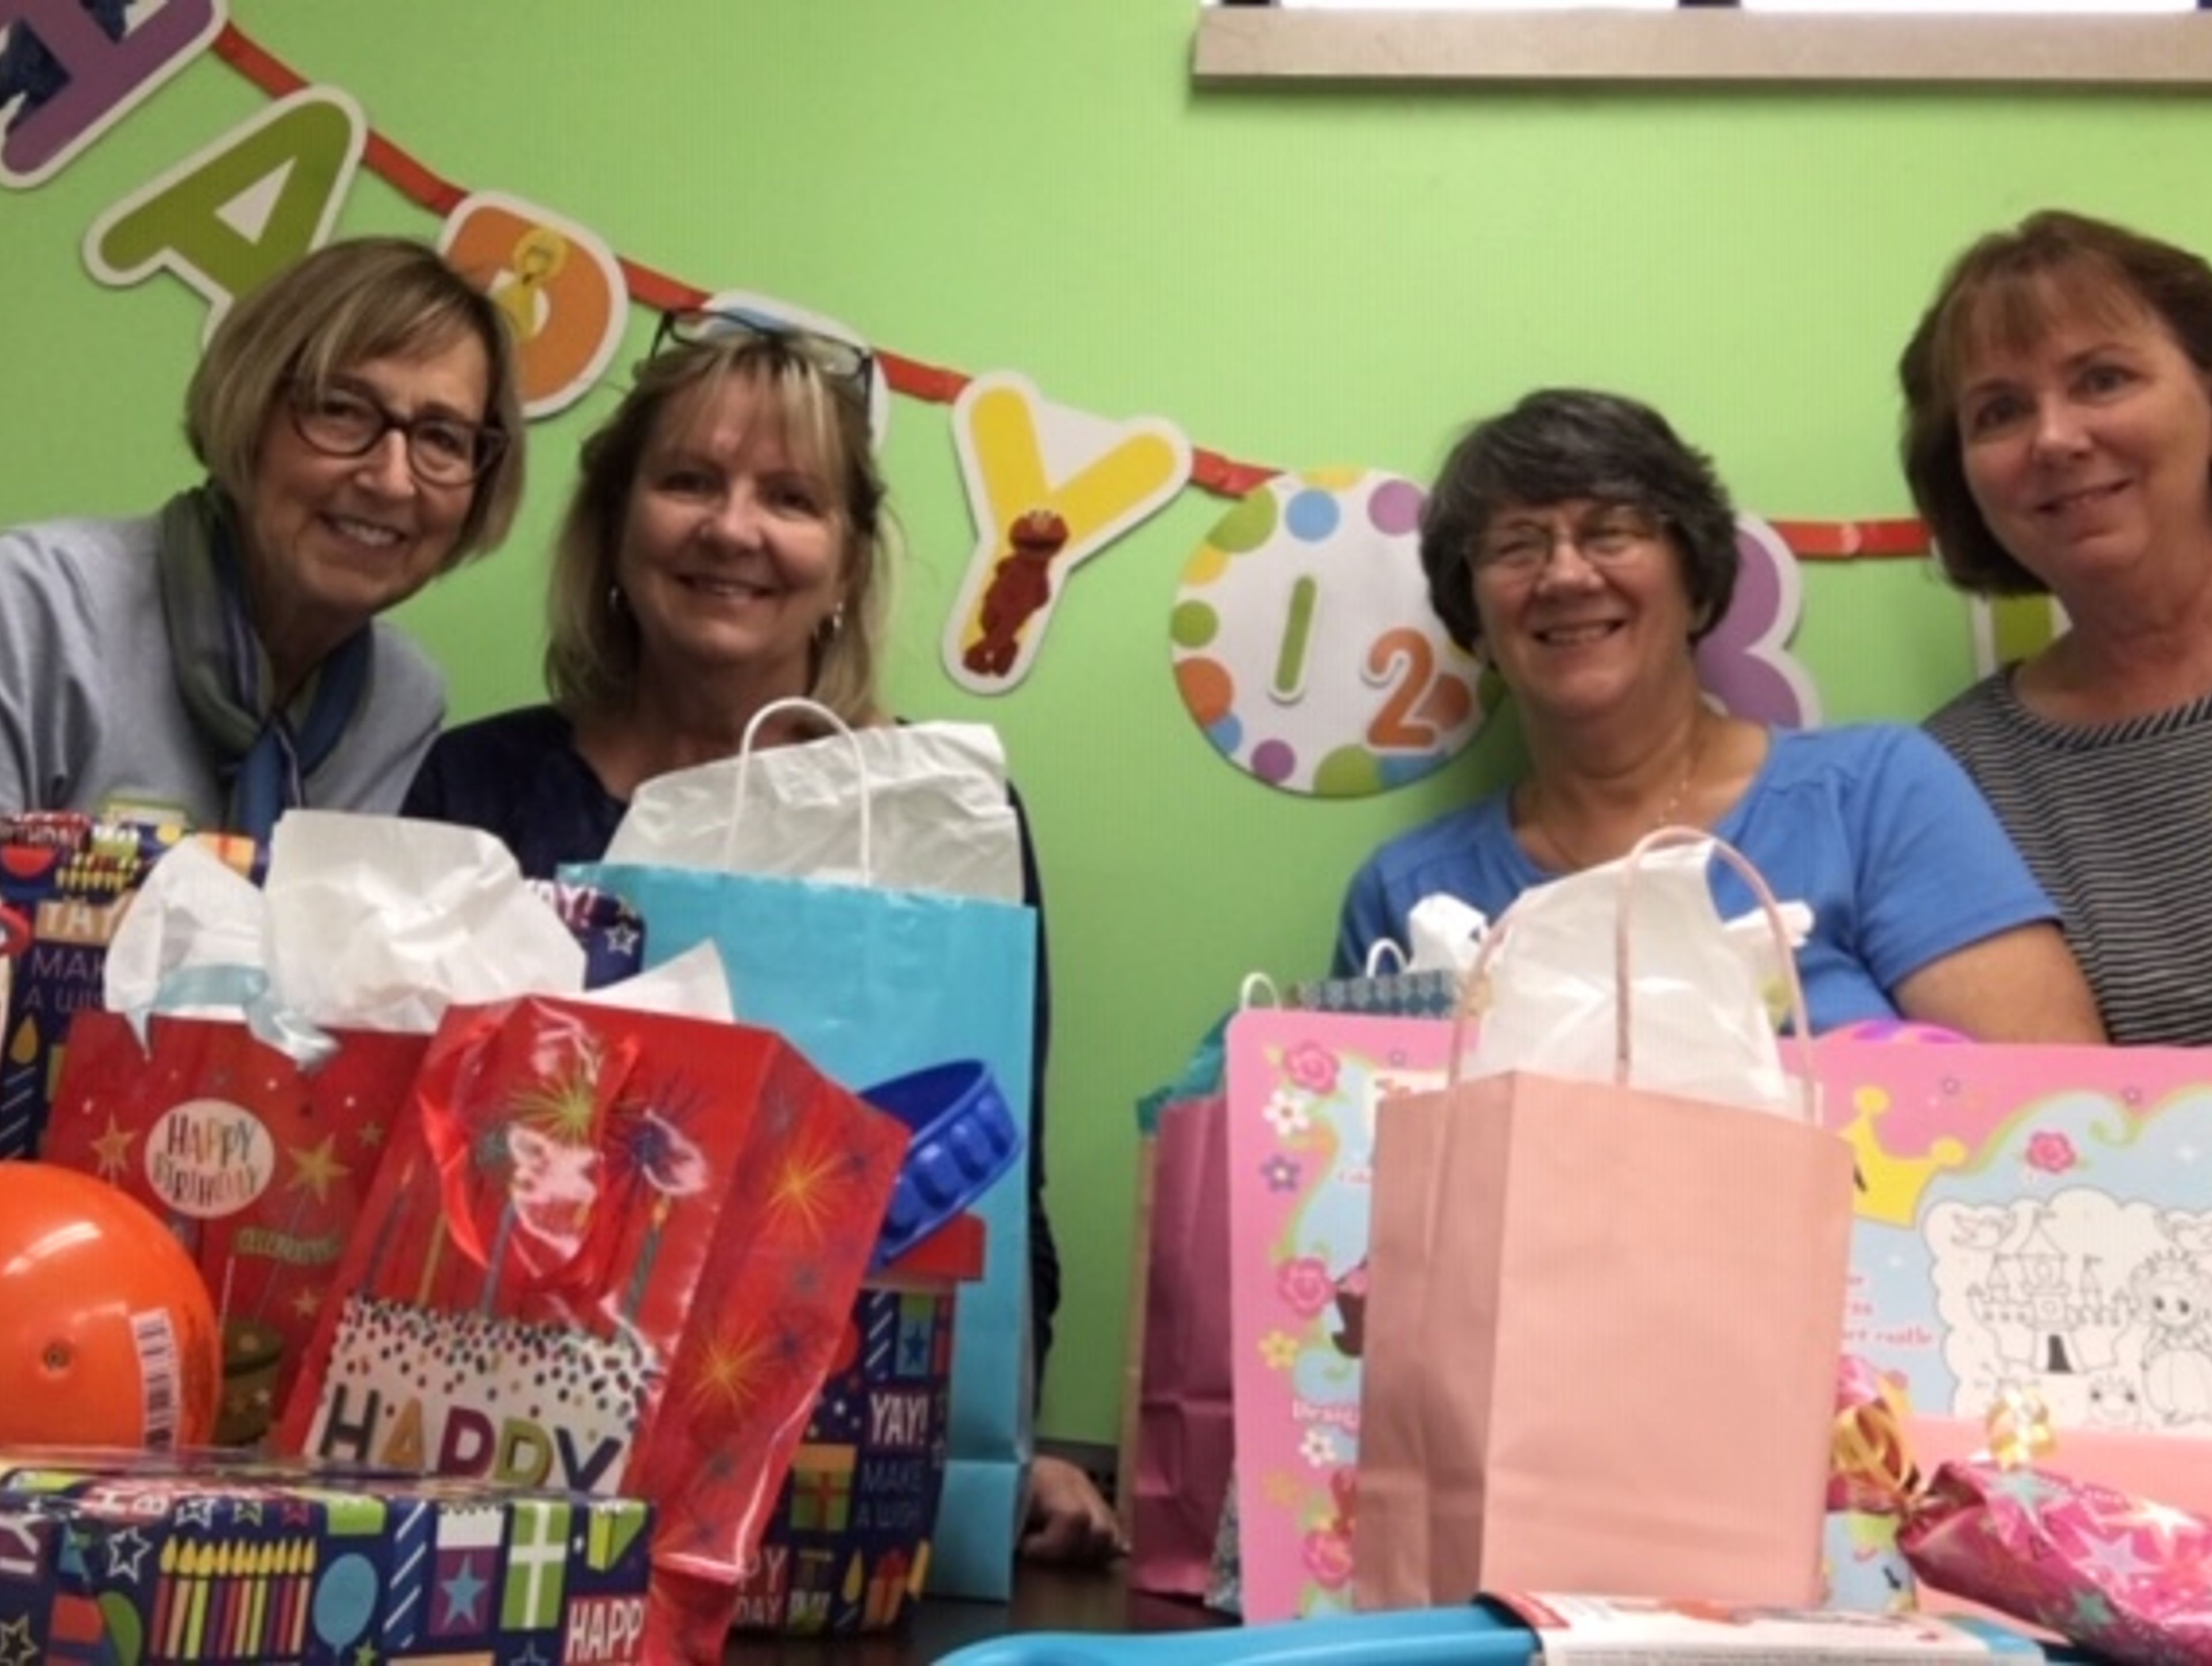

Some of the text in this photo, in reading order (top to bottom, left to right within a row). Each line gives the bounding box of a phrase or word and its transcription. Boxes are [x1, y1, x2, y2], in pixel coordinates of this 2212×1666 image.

[167, 1112, 258, 1168] HAPPY
[318, 1383, 623, 1493] HAPPY
[869, 1391, 929, 1445] YAY!
